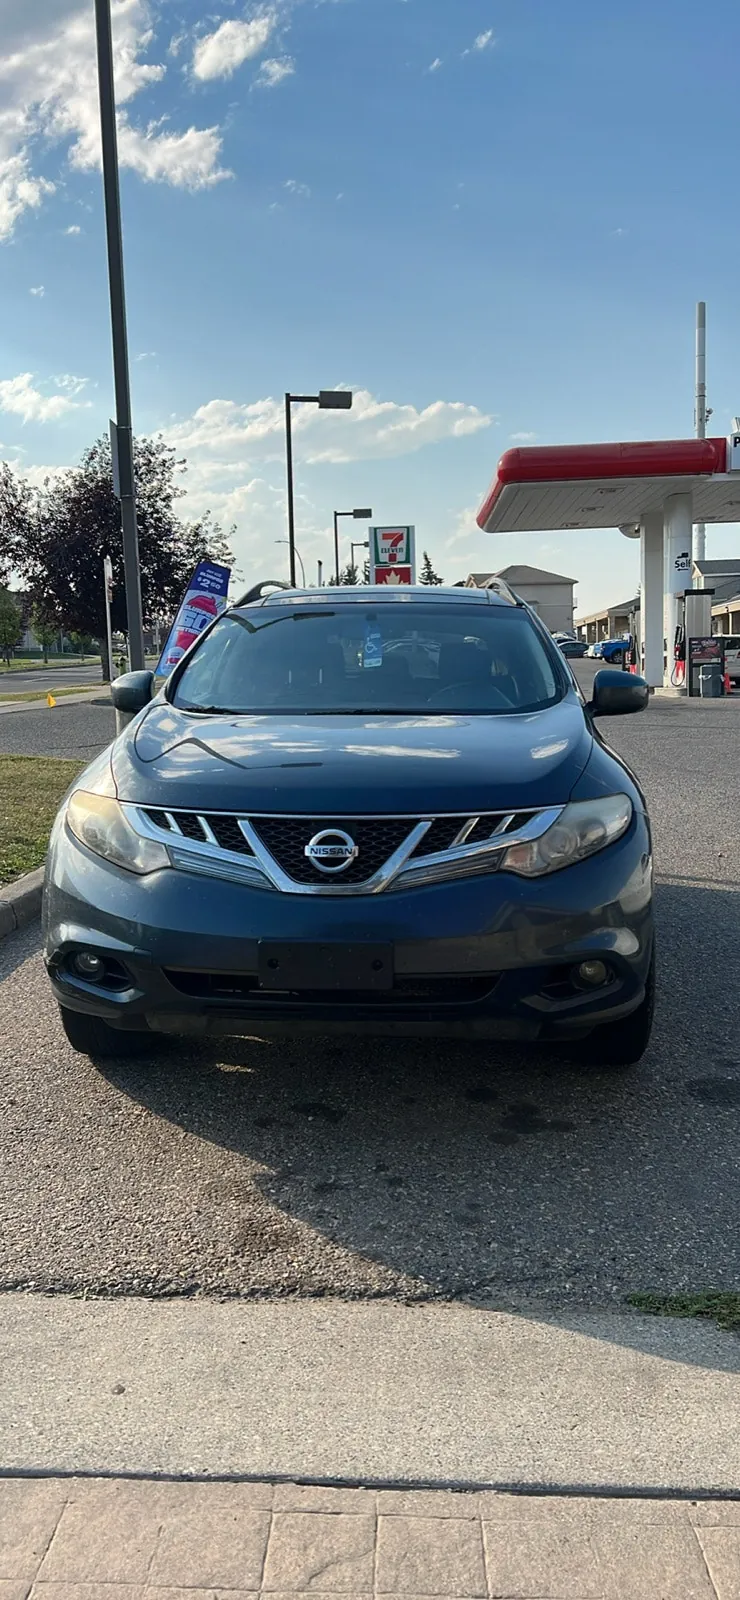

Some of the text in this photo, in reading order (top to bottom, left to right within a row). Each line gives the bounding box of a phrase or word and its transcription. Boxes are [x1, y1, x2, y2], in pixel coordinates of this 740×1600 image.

[381, 532, 404, 562] 7
[674, 558, 692, 569] Self
[310, 847, 353, 855] NISSAN
